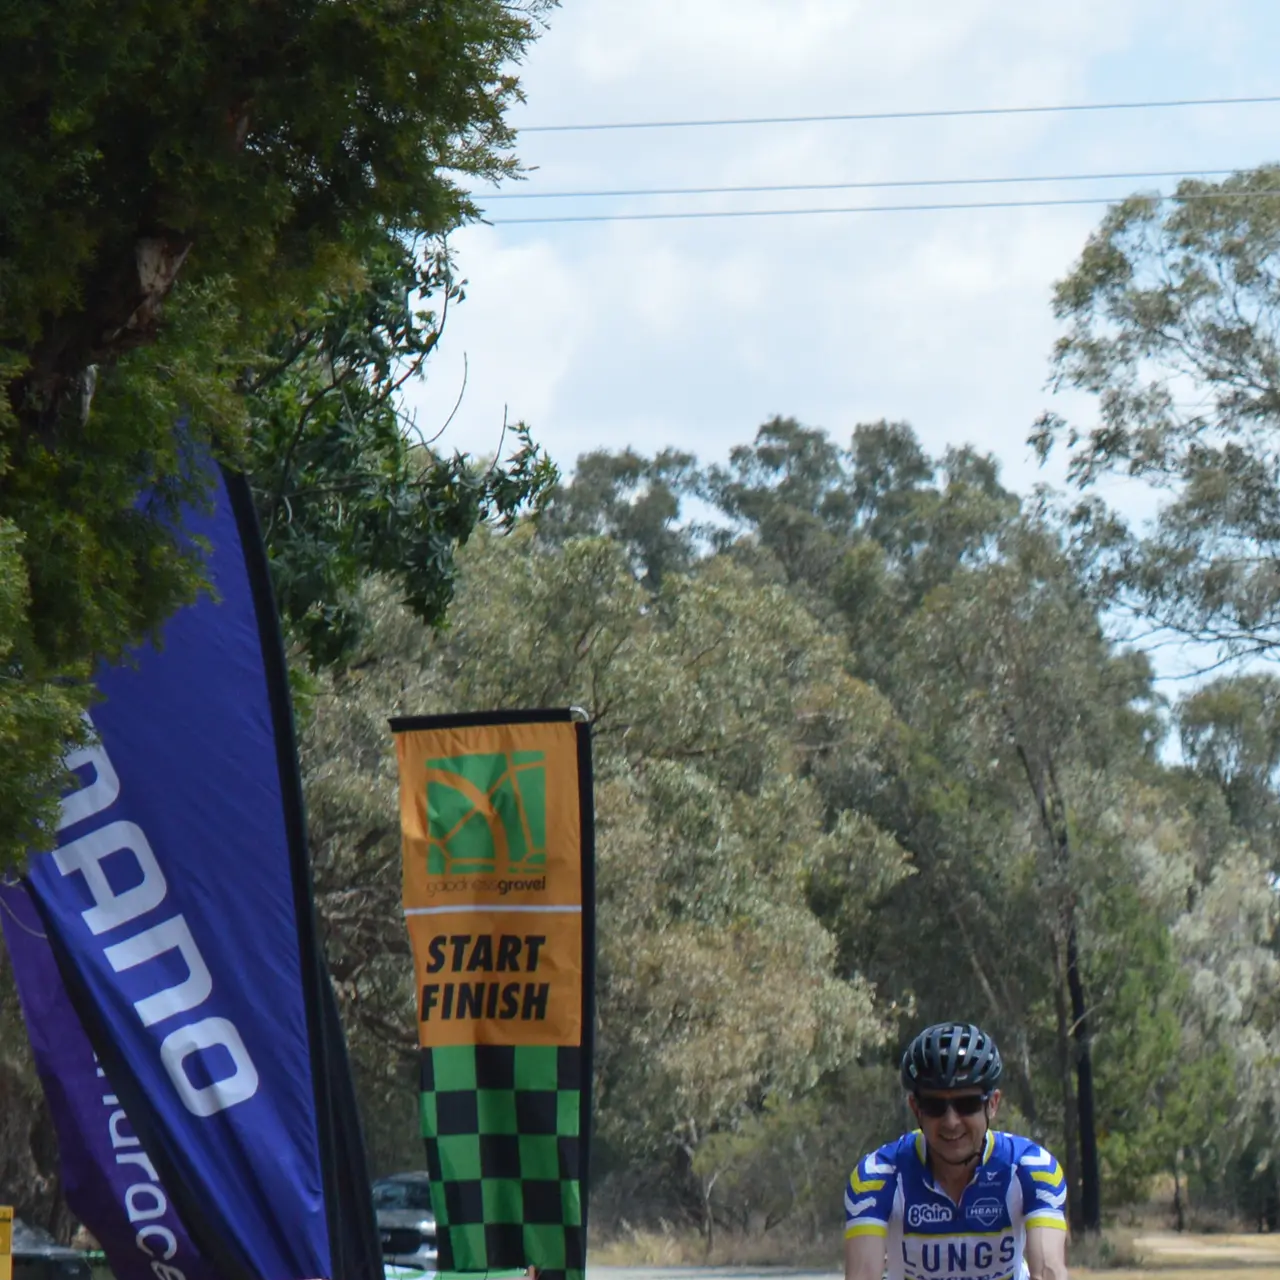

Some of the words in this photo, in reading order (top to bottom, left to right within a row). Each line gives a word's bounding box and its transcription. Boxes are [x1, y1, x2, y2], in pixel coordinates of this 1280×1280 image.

[426, 934, 546, 973] START
[421, 982, 549, 1022] FINISH
[908, 1203, 953, 1228] Brain
[902, 1236, 1015, 1273] LUNGS
